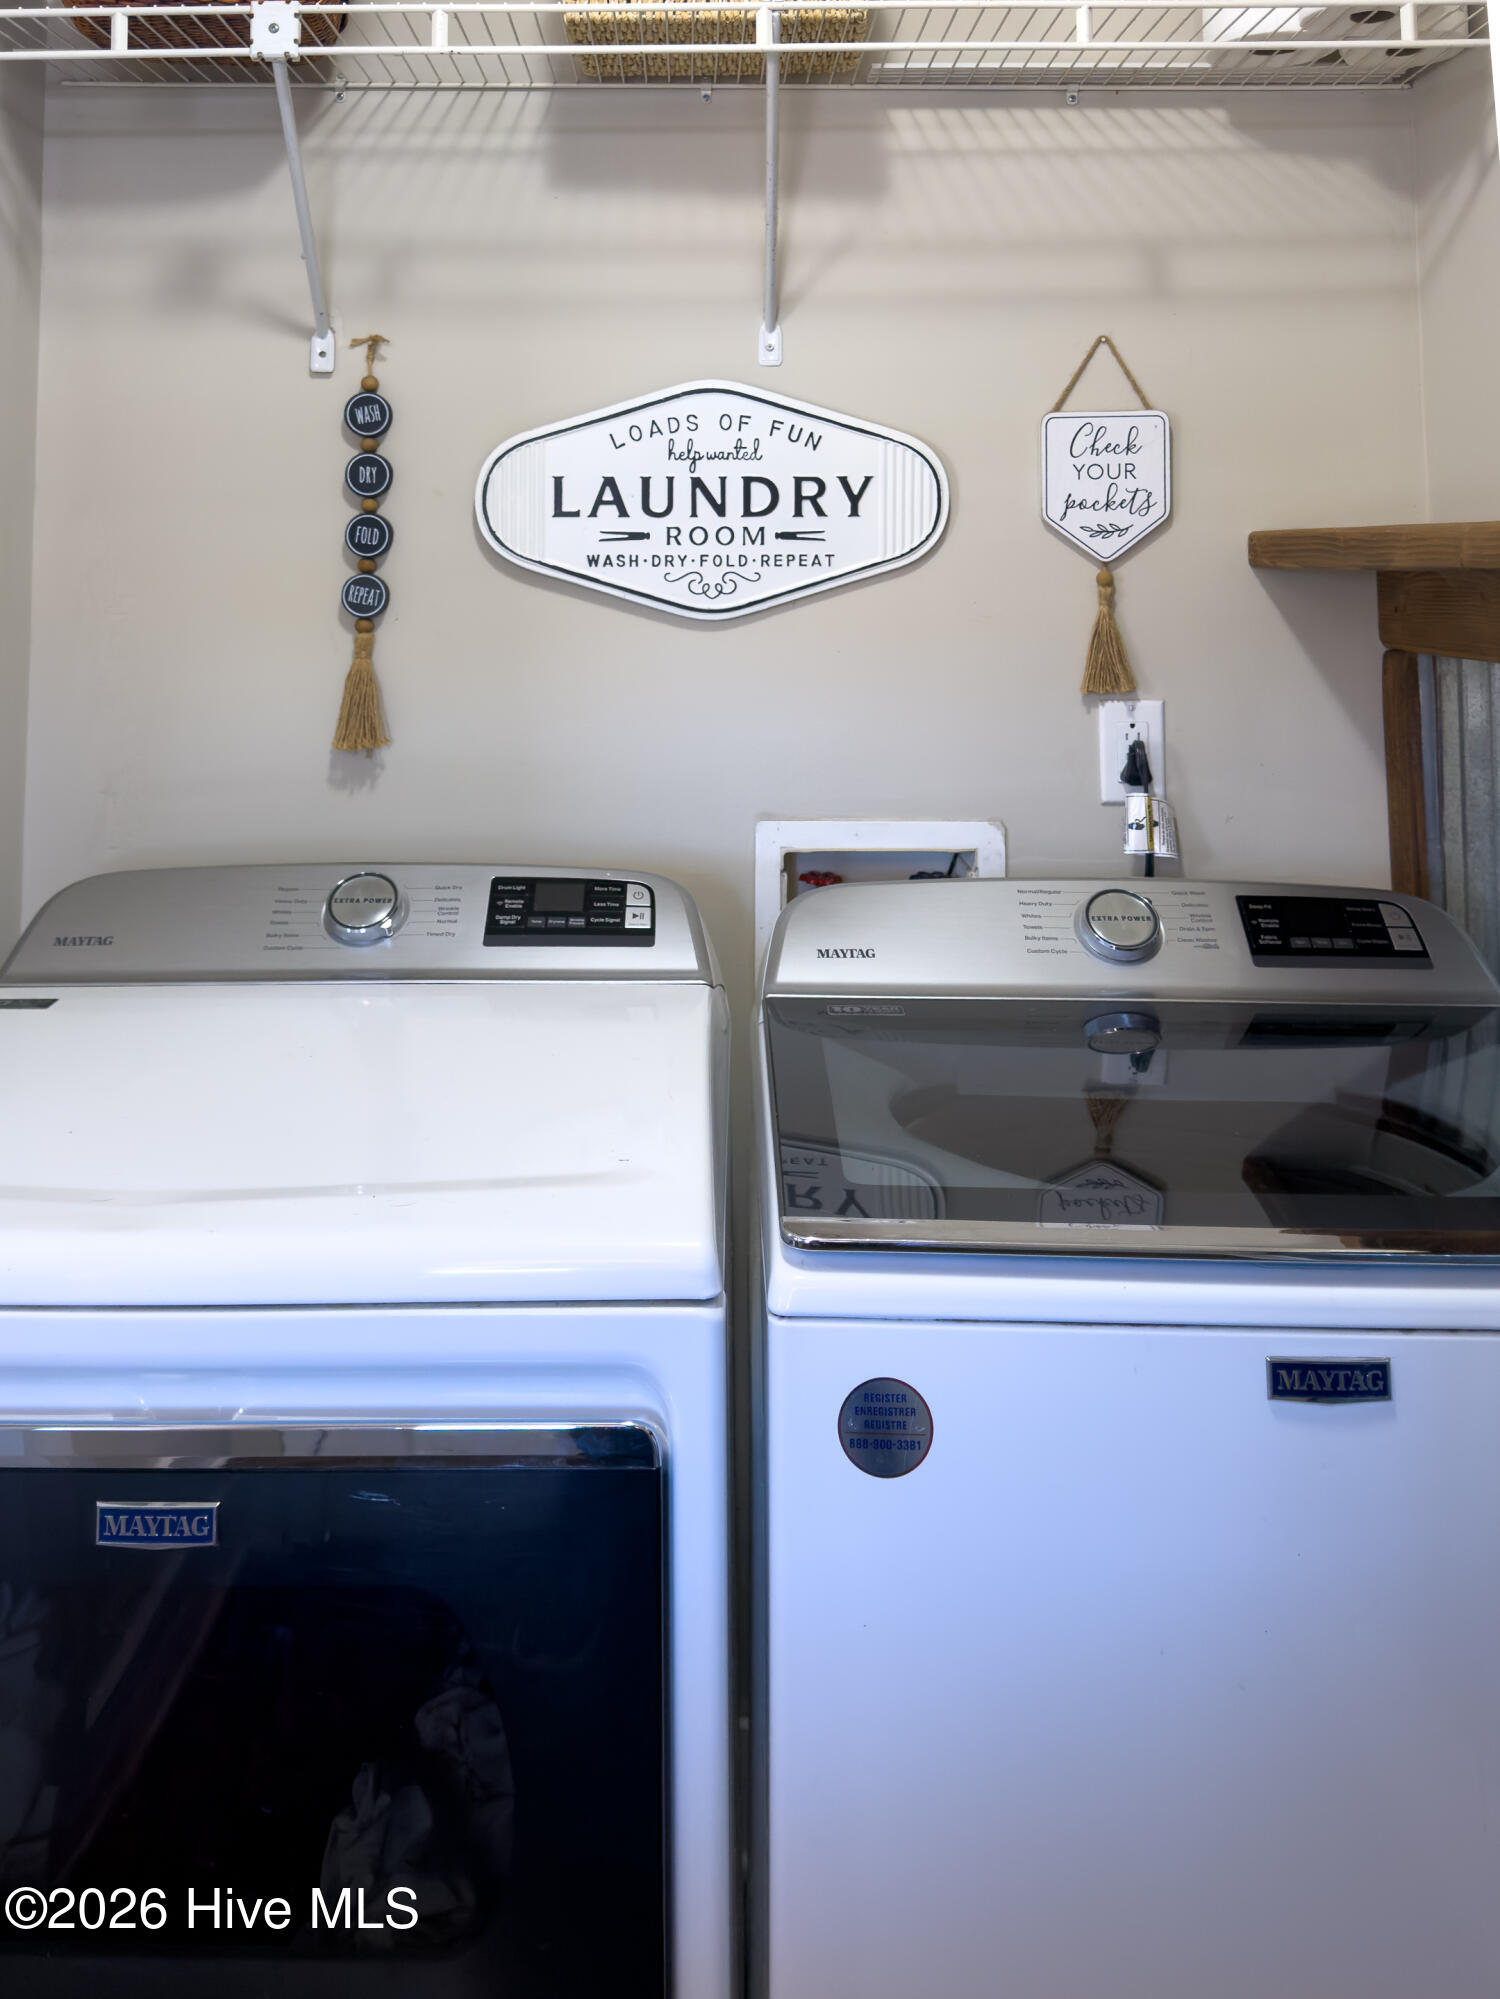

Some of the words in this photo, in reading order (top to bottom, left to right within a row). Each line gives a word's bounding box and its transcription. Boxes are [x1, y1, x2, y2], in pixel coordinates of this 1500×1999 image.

[354, 404, 381, 424] WASH
[609, 414, 699, 450] LOADS
[719, 413, 752, 432] OF
[769, 420, 822, 451] FUN
[1070, 422, 1143, 458] Check
[668, 438, 704, 473] help
[706, 438, 763, 461] wanted
[359, 466, 377, 484] DRY
[1073, 463, 1137, 480] YOUR
[552, 475, 874, 518] LAUNDRY
[1060, 482, 1157, 521] pockets
[355, 526, 379, 545] FOLD
[665, 526, 766, 546] ROOM
[348, 584, 380, 606] REPEAT
[334, 896, 360, 904] EXTRA
[53, 936, 114, 947] MAYTAG
[816, 949, 876, 958] MAYTAG
[1277, 1369, 1384, 1391] MAYTAG
[863, 1392, 907, 1403] REGISTER
[854, 1406, 916, 1416] ENREGISTRER
[863, 1419, 907, 1430] REGISTRE
[103, 1515, 210, 1537] MAYTAG
